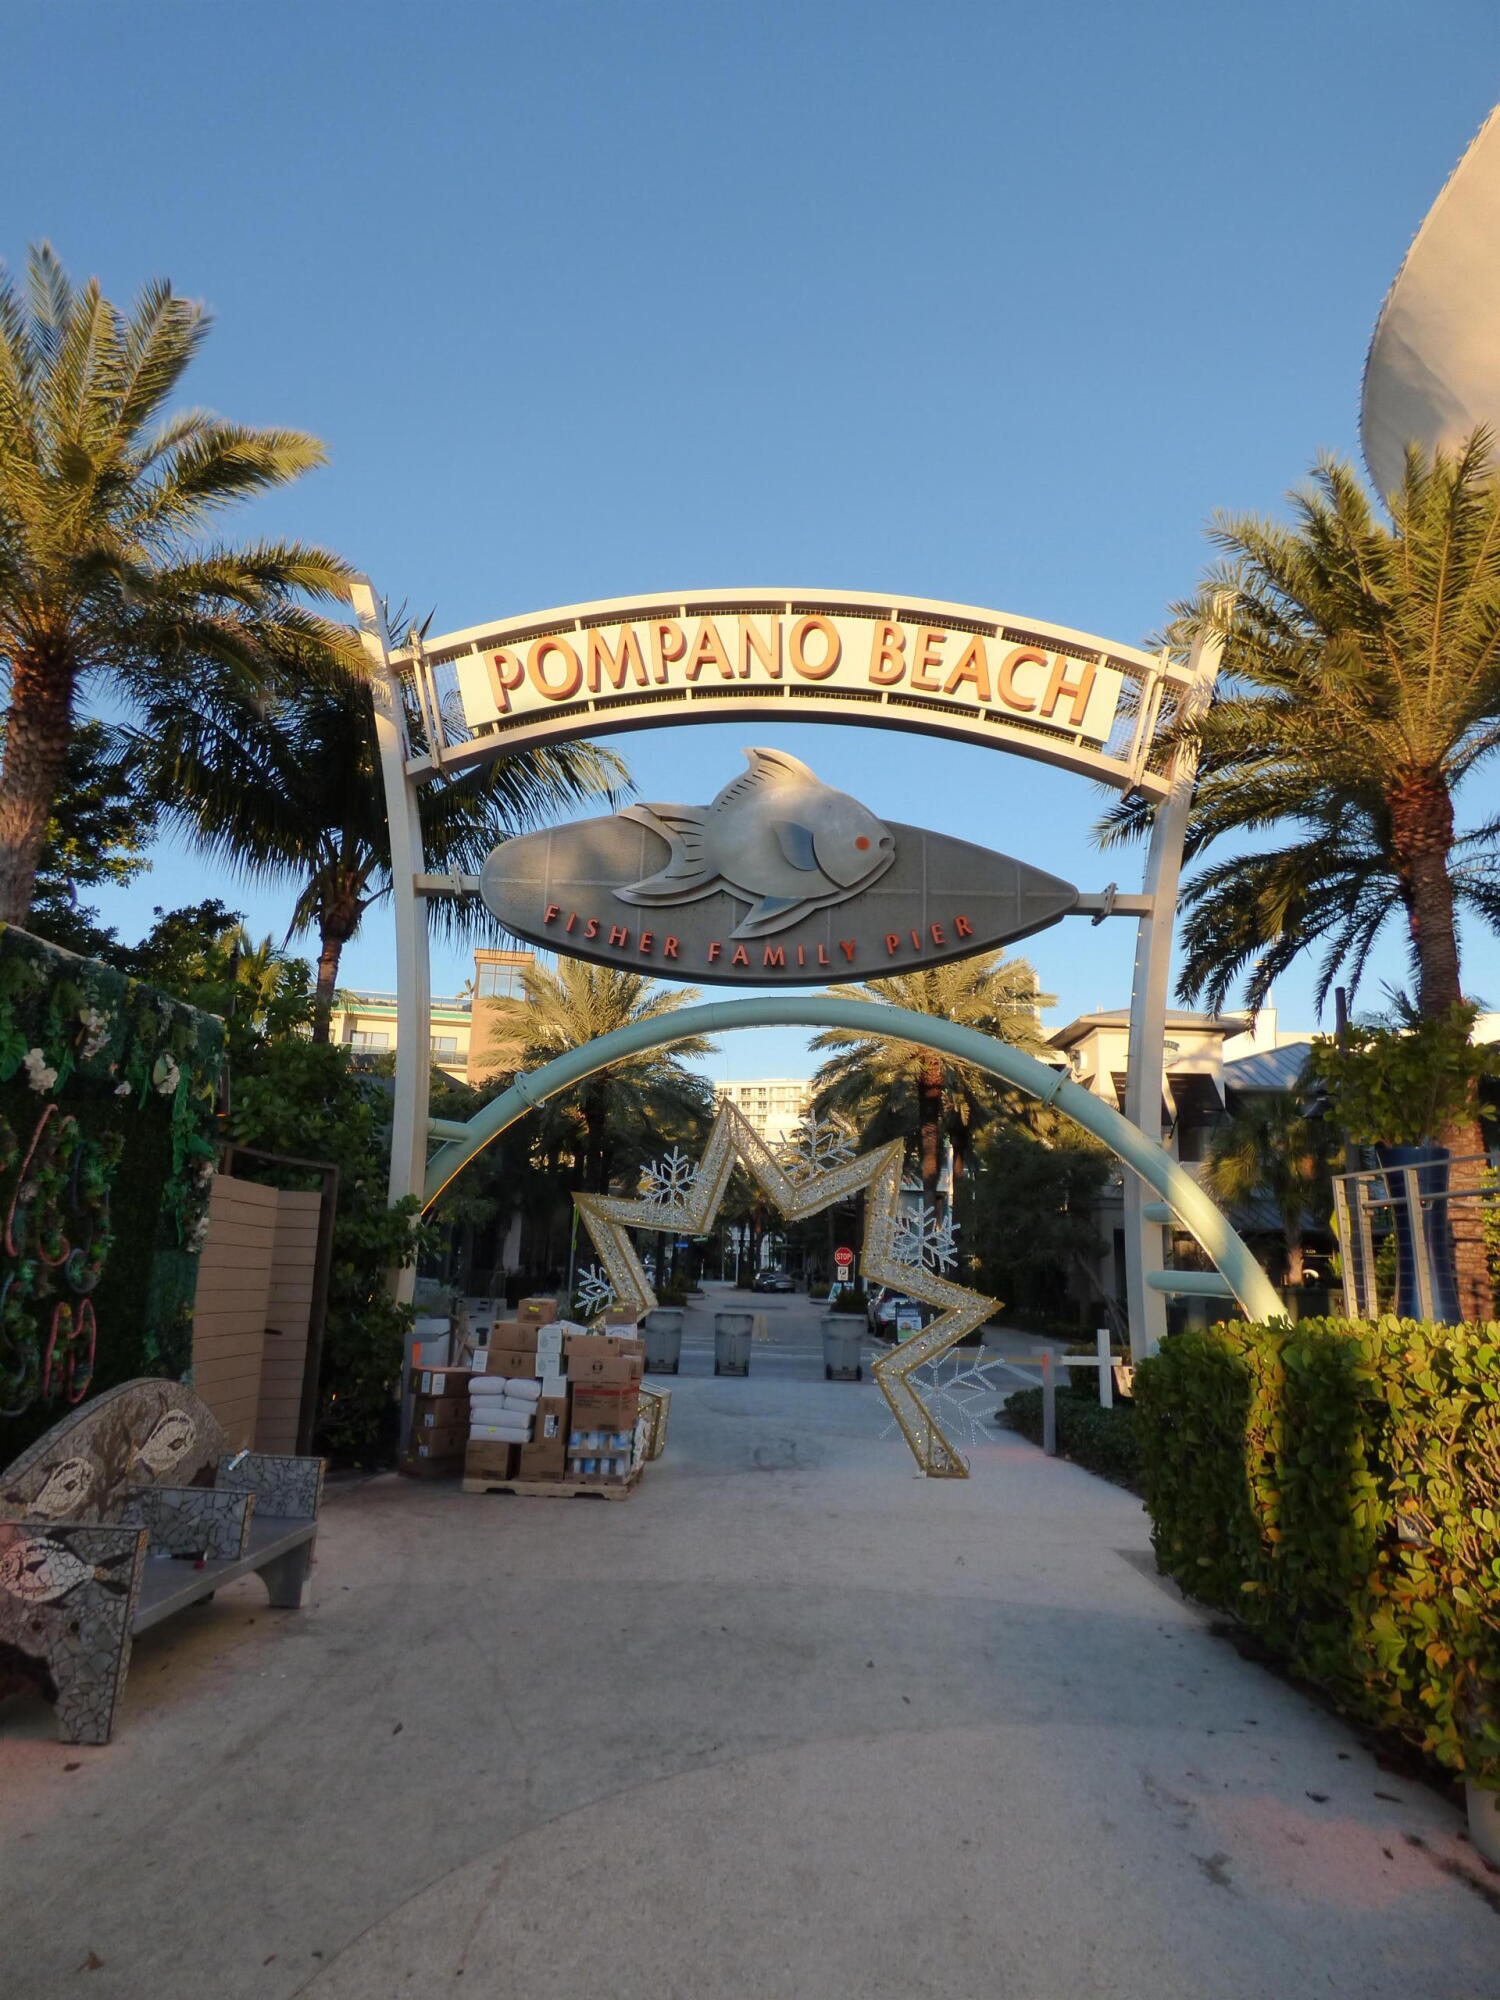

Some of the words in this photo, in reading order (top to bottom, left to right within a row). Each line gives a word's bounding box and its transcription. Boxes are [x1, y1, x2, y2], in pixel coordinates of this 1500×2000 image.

[485, 614, 841, 713] POMPANO
[868, 620, 1097, 726] BEACH
[543, 903, 680, 958] FISHER
[707, 939, 857, 966] FAMILY
[885, 915, 974, 955] PIER
